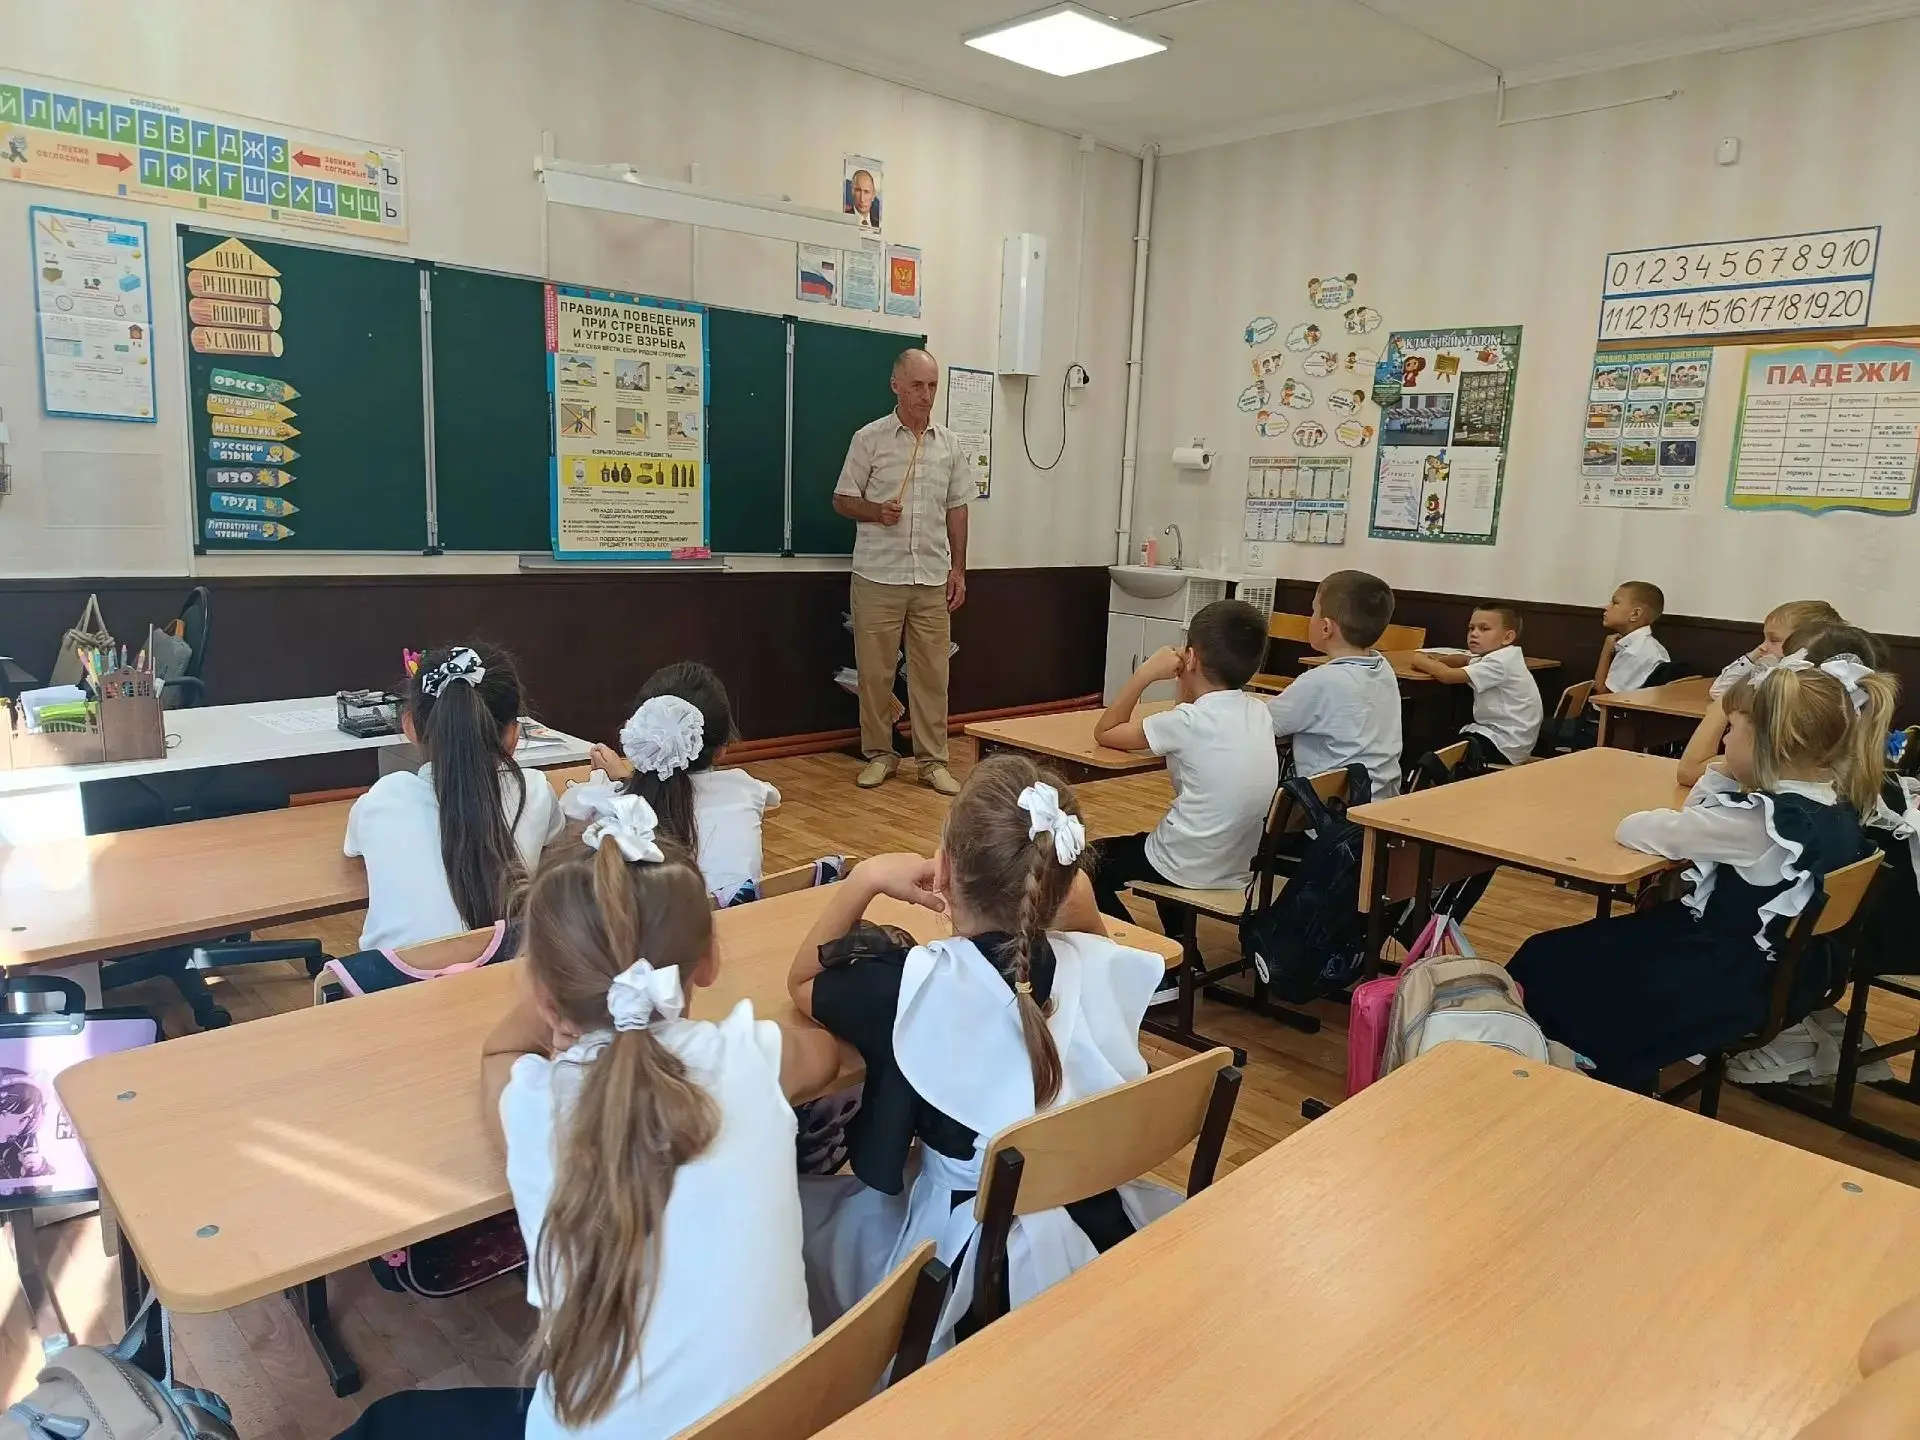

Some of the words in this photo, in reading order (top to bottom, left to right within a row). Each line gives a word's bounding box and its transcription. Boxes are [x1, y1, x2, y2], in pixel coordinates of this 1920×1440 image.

[29, 99, 46, 120] Л
[56, 104, 77, 125] М
[87, 110, 104, 130] Н
[115, 115, 131, 133] Р
[143, 120, 159, 139] Б
[170, 126, 185, 144] В
[197, 130, 209, 148] Г
[221, 134, 238, 156] Д
[243, 140, 264, 160] Ж
[271, 145, 284, 163] З
[382, 168, 398, 185] Ъ
[144, 158, 160, 178] П
[170, 163, 188, 182] Ф
[198, 167, 212, 187] К
[223, 172, 237, 190] Т
[245, 177, 264, 196] Ш
[271, 181, 286, 199] С
[295, 184, 309, 203] Х
[318, 186, 333, 209] Ц
[341, 193, 354, 210] Ч
[361, 194, 379, 217] Щ
[385, 201, 397, 218] Ь
[1612, 262, 1628, 287] 0
[1635, 260, 1646, 285] 1
[1648, 258, 1666, 285] 2
[1672, 256, 1688, 282] 3
[1696, 254, 1711, 279] 4
[1720, 251, 1739, 278] 5
[1745, 249, 1764, 275] 6
[1771, 247, 1788, 274] 7
[1792, 244, 1811, 271] 8
[1816, 241, 1837, 269] 9
[1842, 238, 1871, 268] 10
[212, 304, 262, 325] ВОПРОС
[560, 302, 620, 319] ПРАВИЛА
[623, 310, 696, 328] ПОВЕДЕНИЯ
[1625, 305, 1647, 330] 12
[1649, 303, 1670, 329] 13
[1672, 302, 1694, 327] 14
[1697, 299, 1720, 325] 15
[1723, 298, 1745, 324] 16
[1749, 295, 1776, 322] 17
[1777, 294, 1802, 321] 18
[1804, 292, 1829, 319] 19
[1828, 289, 1863, 318] 20
[581, 317, 607, 329] ПРИ
[610, 320, 674, 337] СТРЕЛЬБЕ
[205, 331, 261, 350] УСЛОВИЕ
[573, 328, 582, 339] И
[586, 330, 633, 345] УГРОЗЕ
[637, 335, 687, 350] ВЗРЫВА
[1766, 361, 1912, 387] ПАДЕЖИ
[217, 471, 254, 483] ИЗО
[221, 495, 257, 511] ТРУД
